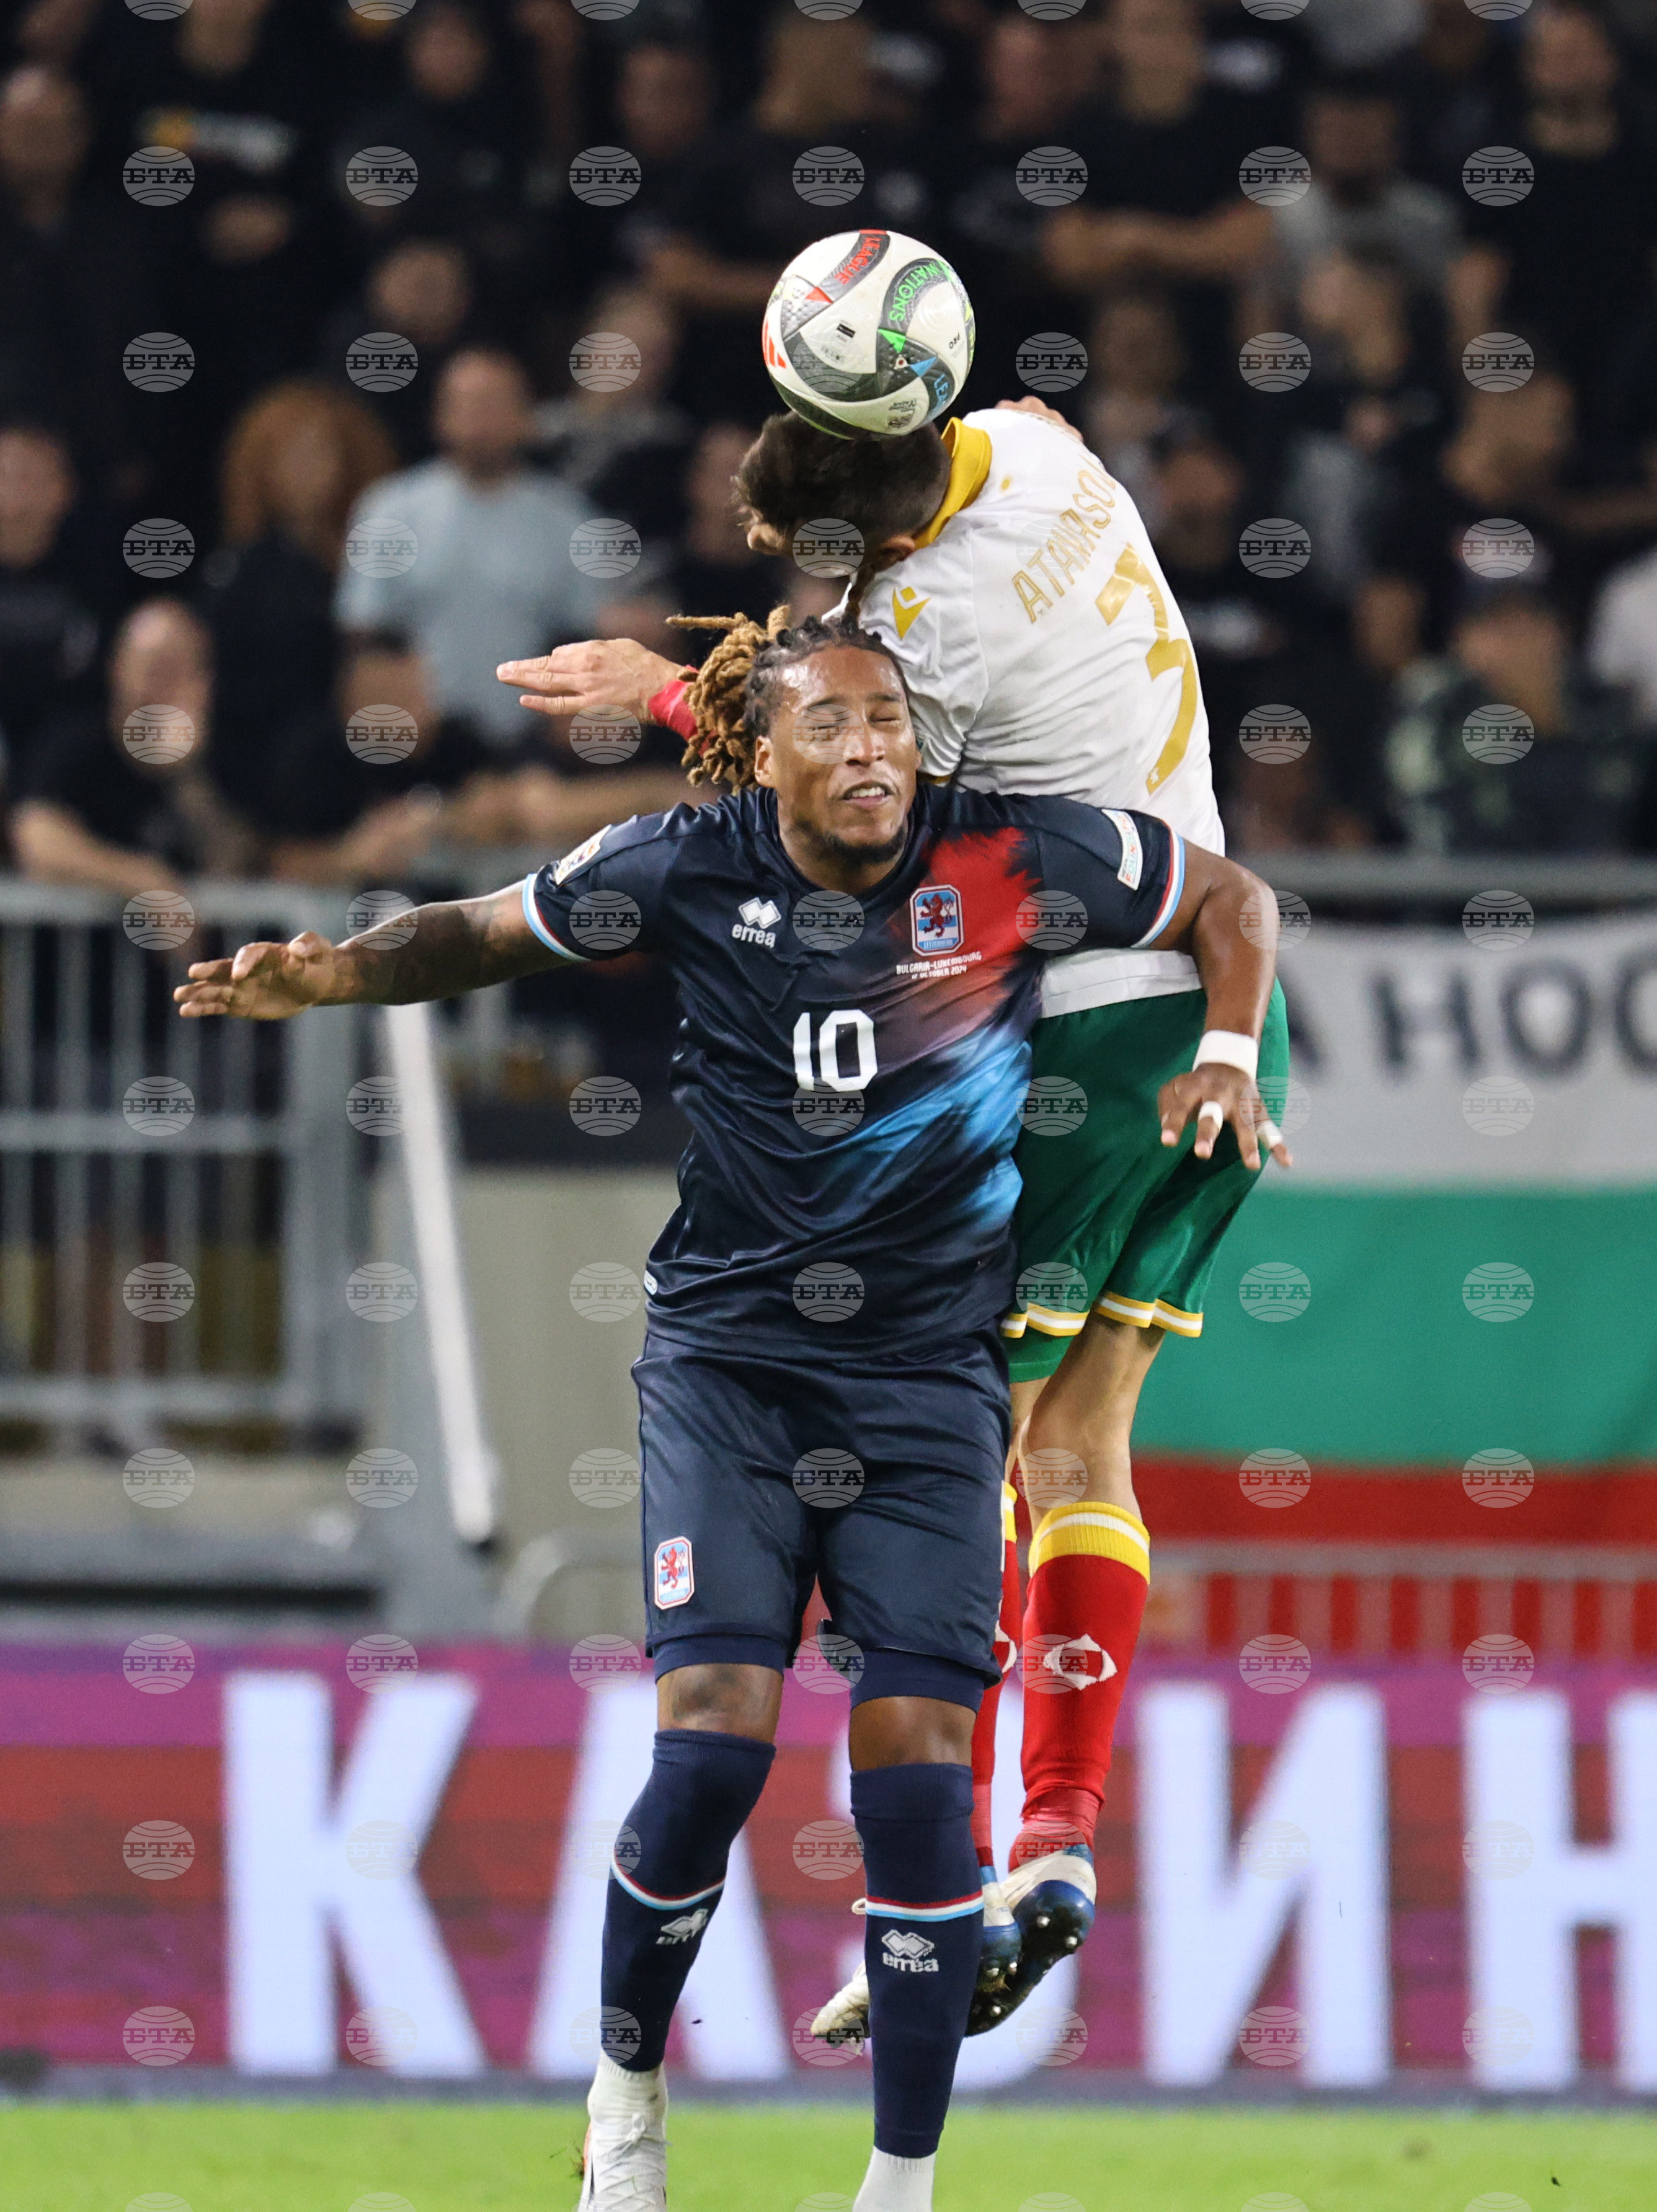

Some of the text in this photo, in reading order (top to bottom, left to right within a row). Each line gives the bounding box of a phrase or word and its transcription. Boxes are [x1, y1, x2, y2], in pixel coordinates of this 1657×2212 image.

[834, 236, 882, 285] LEAGUE
[889, 261, 941, 321] NATIONS
[895, 950, 982, 975] BULGARIA-LUXEMBOURG
[920, 967, 949, 978] OCTOBER
[793, 1009, 877, 1092] 10
[222, 1668, 1657, 2092] КАИН
